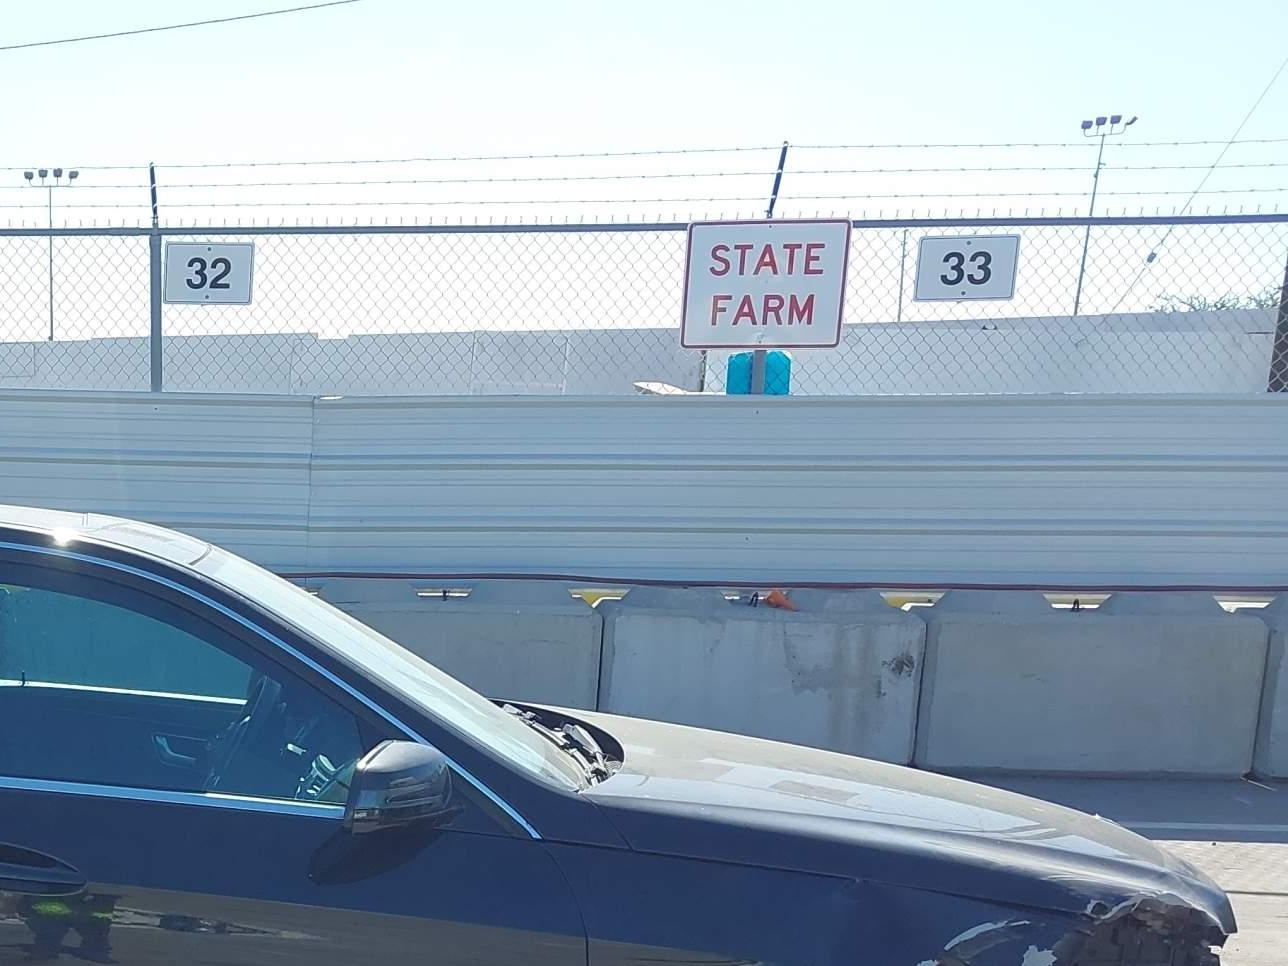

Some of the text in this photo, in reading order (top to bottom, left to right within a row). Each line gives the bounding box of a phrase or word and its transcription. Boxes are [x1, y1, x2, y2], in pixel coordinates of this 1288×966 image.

[185, 257, 232, 290] 32
[709, 243, 826, 277] STATE
[940, 250, 992, 286] 33
[711, 294, 815, 326] FARM
